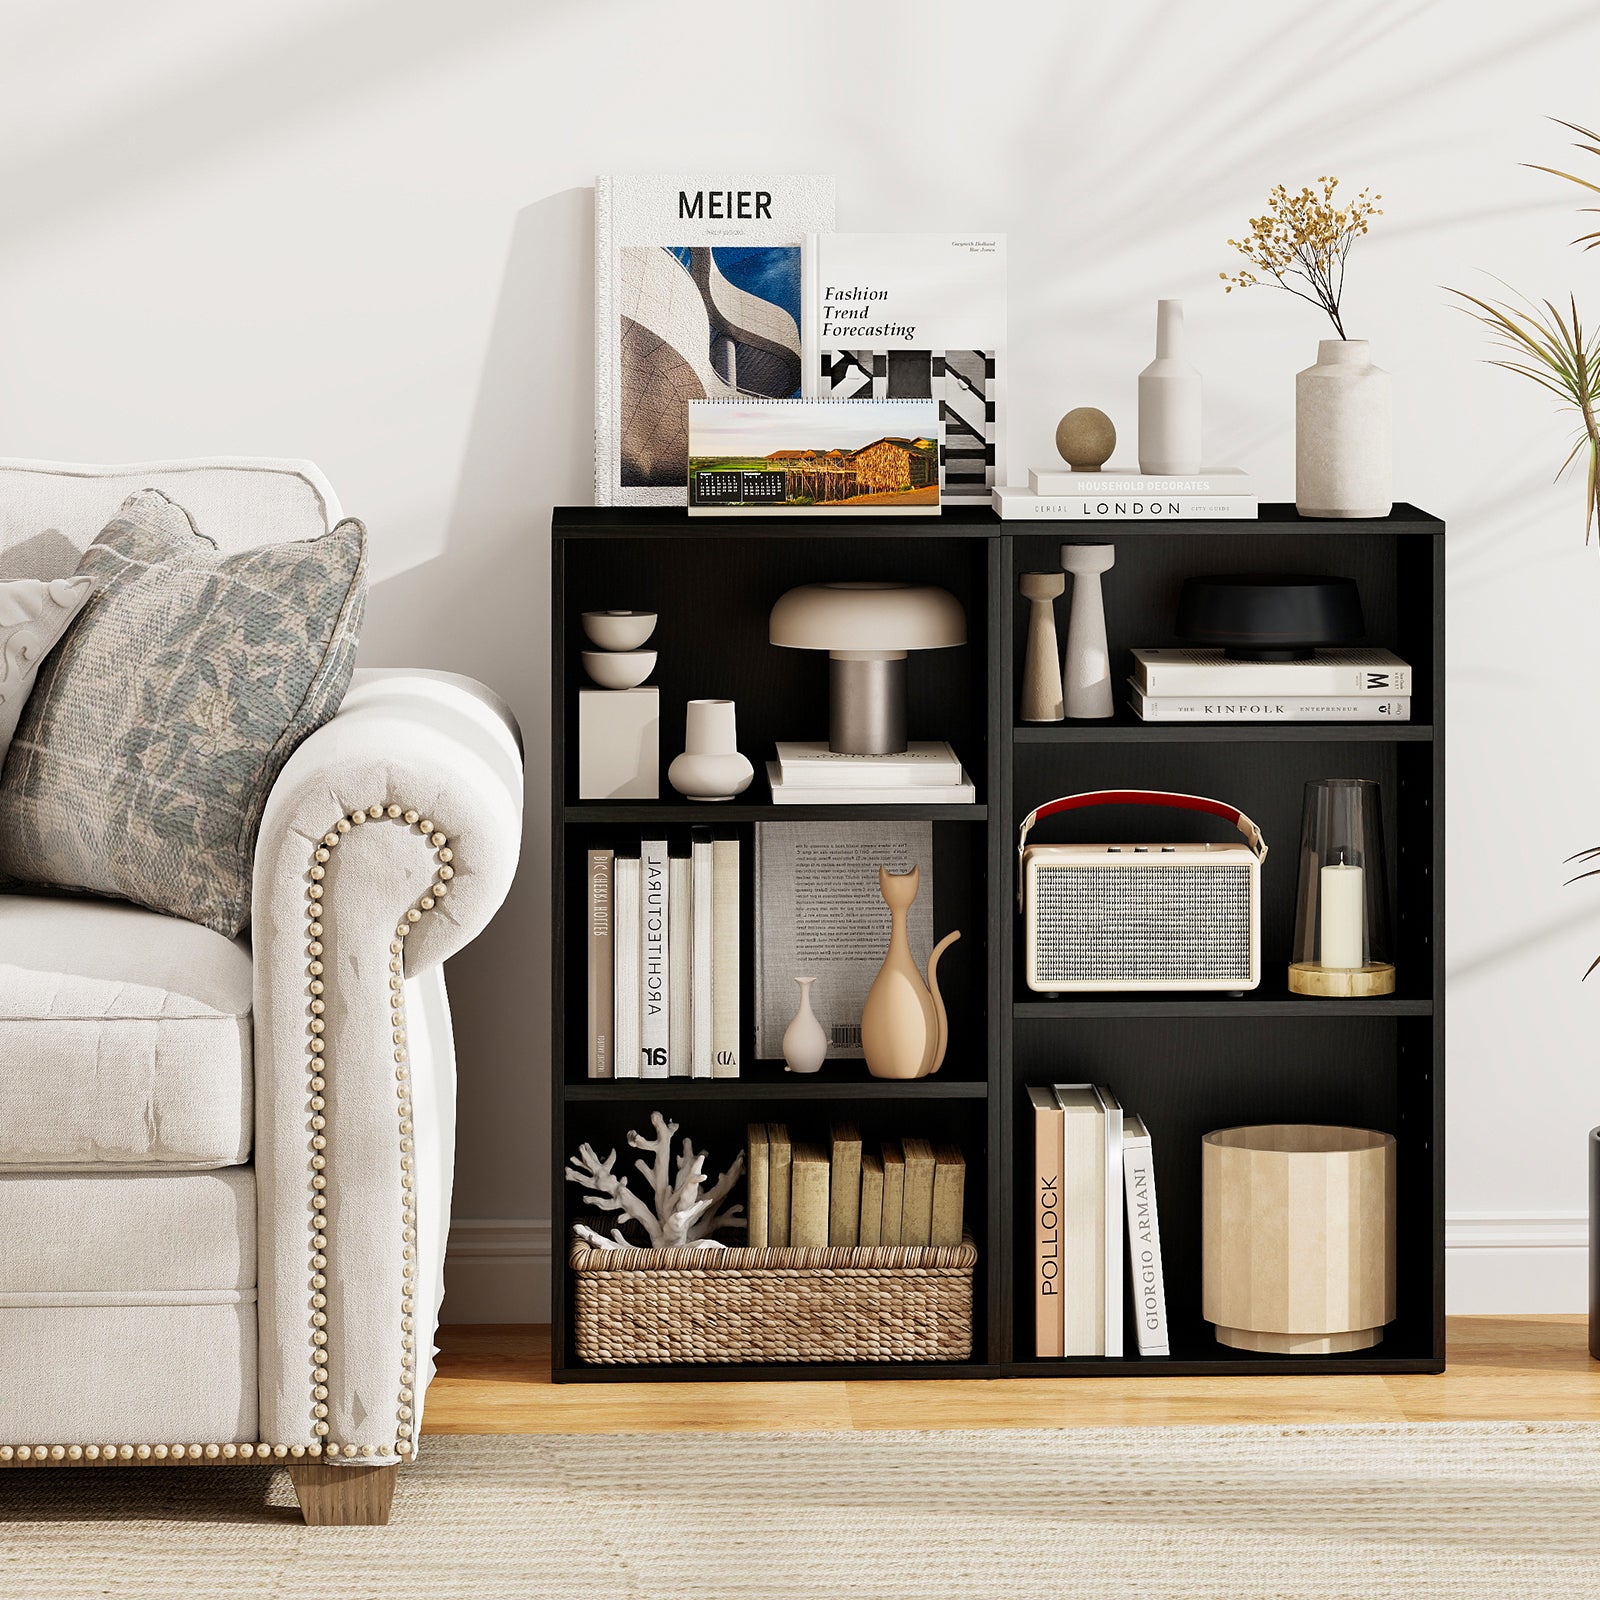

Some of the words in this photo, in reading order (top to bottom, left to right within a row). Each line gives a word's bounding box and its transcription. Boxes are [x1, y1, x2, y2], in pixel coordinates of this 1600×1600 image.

[679, 191, 772, 219] MEIER
[824, 286, 889, 301] Fashion
[823, 305, 870, 319] Trend
[822, 322, 916, 341] Forecasting
[1078, 481, 1144, 491] HOUSEHOLD
[1147, 481, 1210, 491] DECORATES
[1034, 505, 1067, 513] CEREAL
[1083, 502, 1180, 515] LONDON
[1367, 673, 1390, 690] M
[1204, 705, 1284, 714] KINFOLK
[1134, 1168, 1152, 1243] ARMANI
[1041, 1175, 1058, 1296] POLLOCK
[1142, 1250, 1159, 1331] GIORGIO
